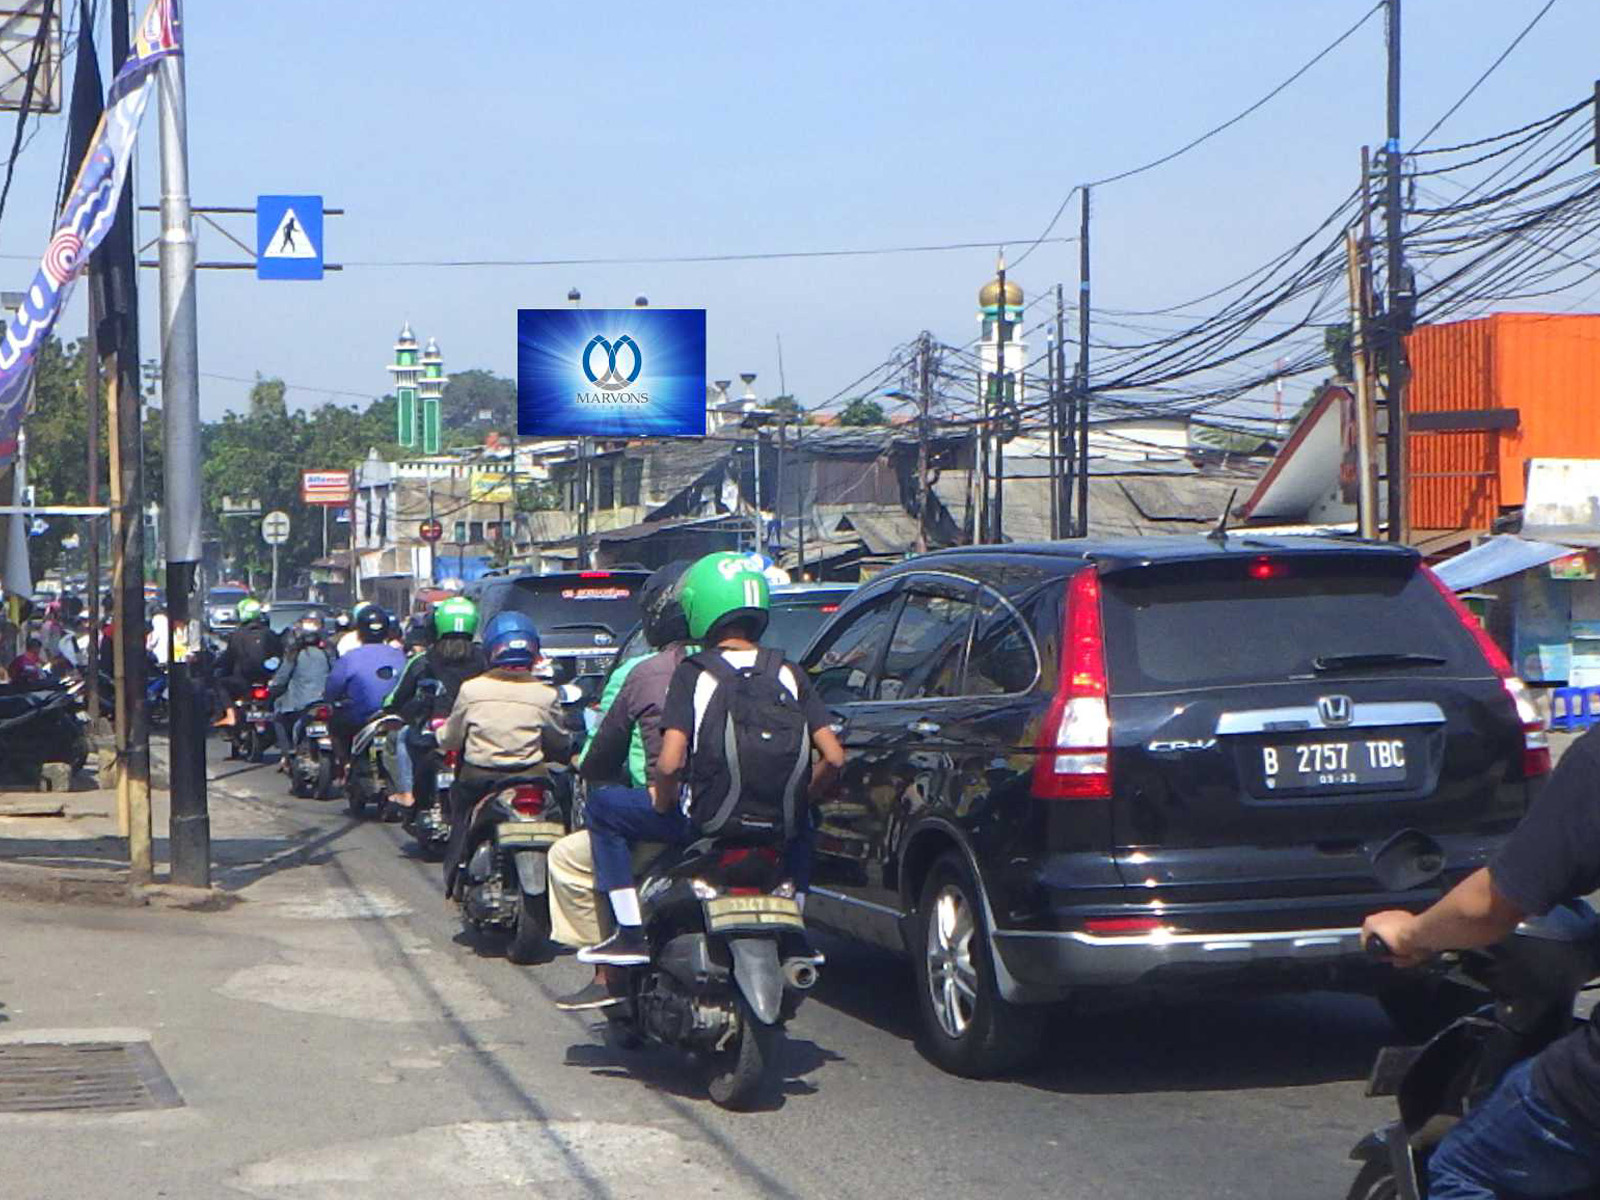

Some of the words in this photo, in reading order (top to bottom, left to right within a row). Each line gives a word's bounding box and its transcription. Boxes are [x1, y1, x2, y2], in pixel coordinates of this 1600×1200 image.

[576, 392, 649, 404] MARVONS
[1263, 747, 1279, 775] B
[1296, 743, 1348, 773] 2757
[1366, 740, 1405, 768] TBC
